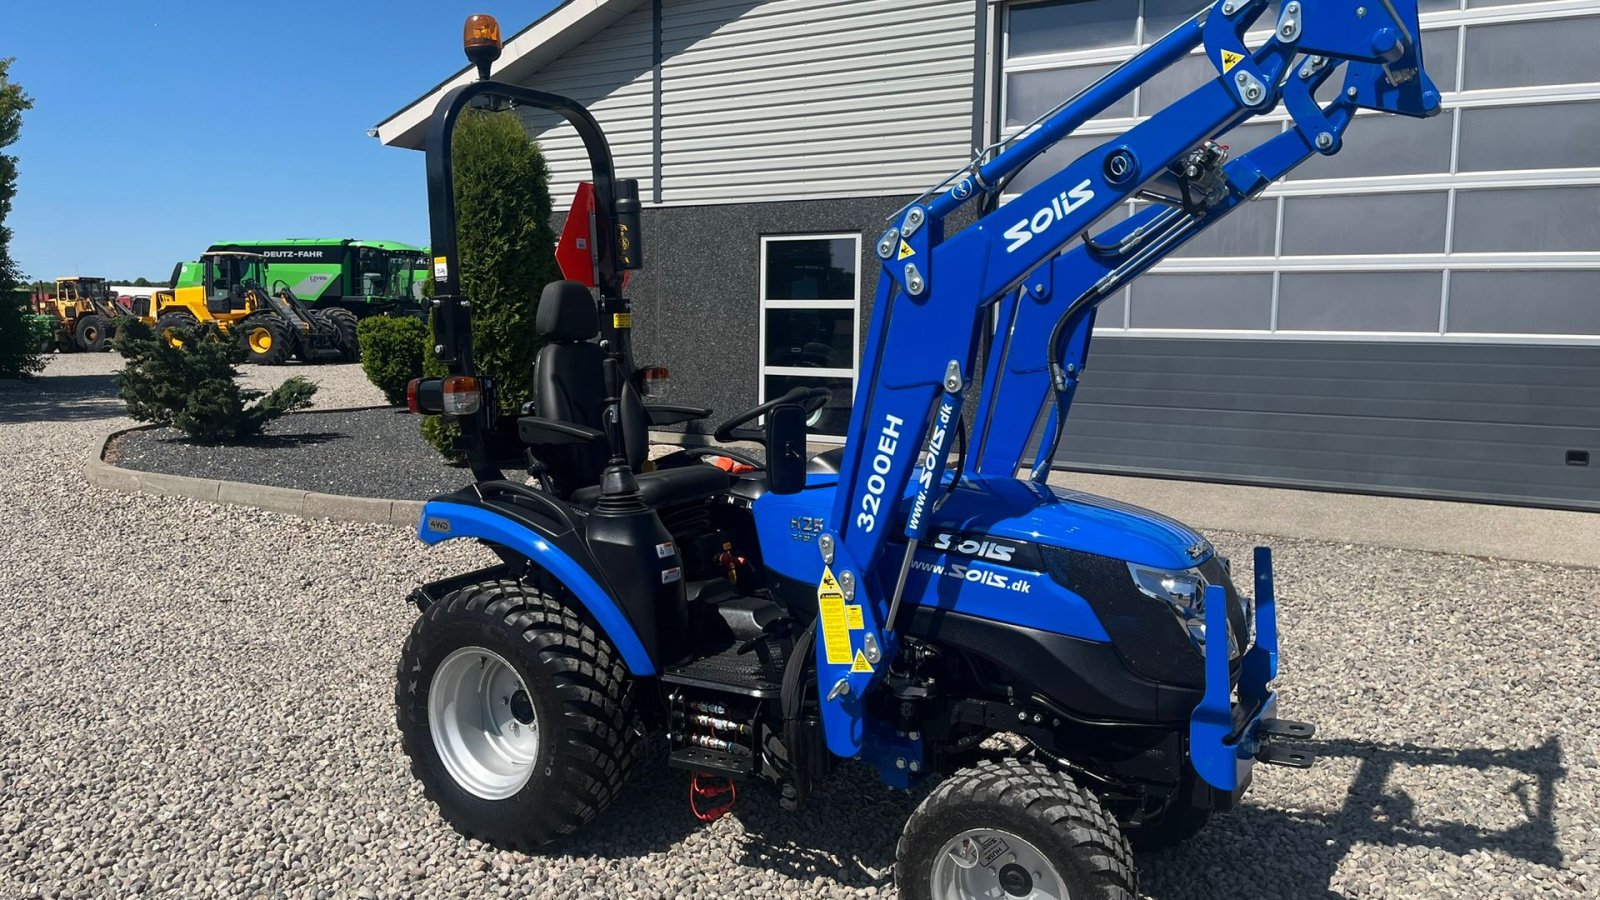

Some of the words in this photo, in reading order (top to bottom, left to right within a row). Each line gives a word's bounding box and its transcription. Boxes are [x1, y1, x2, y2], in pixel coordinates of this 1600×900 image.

[263, 250, 324, 258] DEUTZ-FAHR
[857, 413, 904, 533] 3200EH
[430, 520, 449, 530] 4WD
